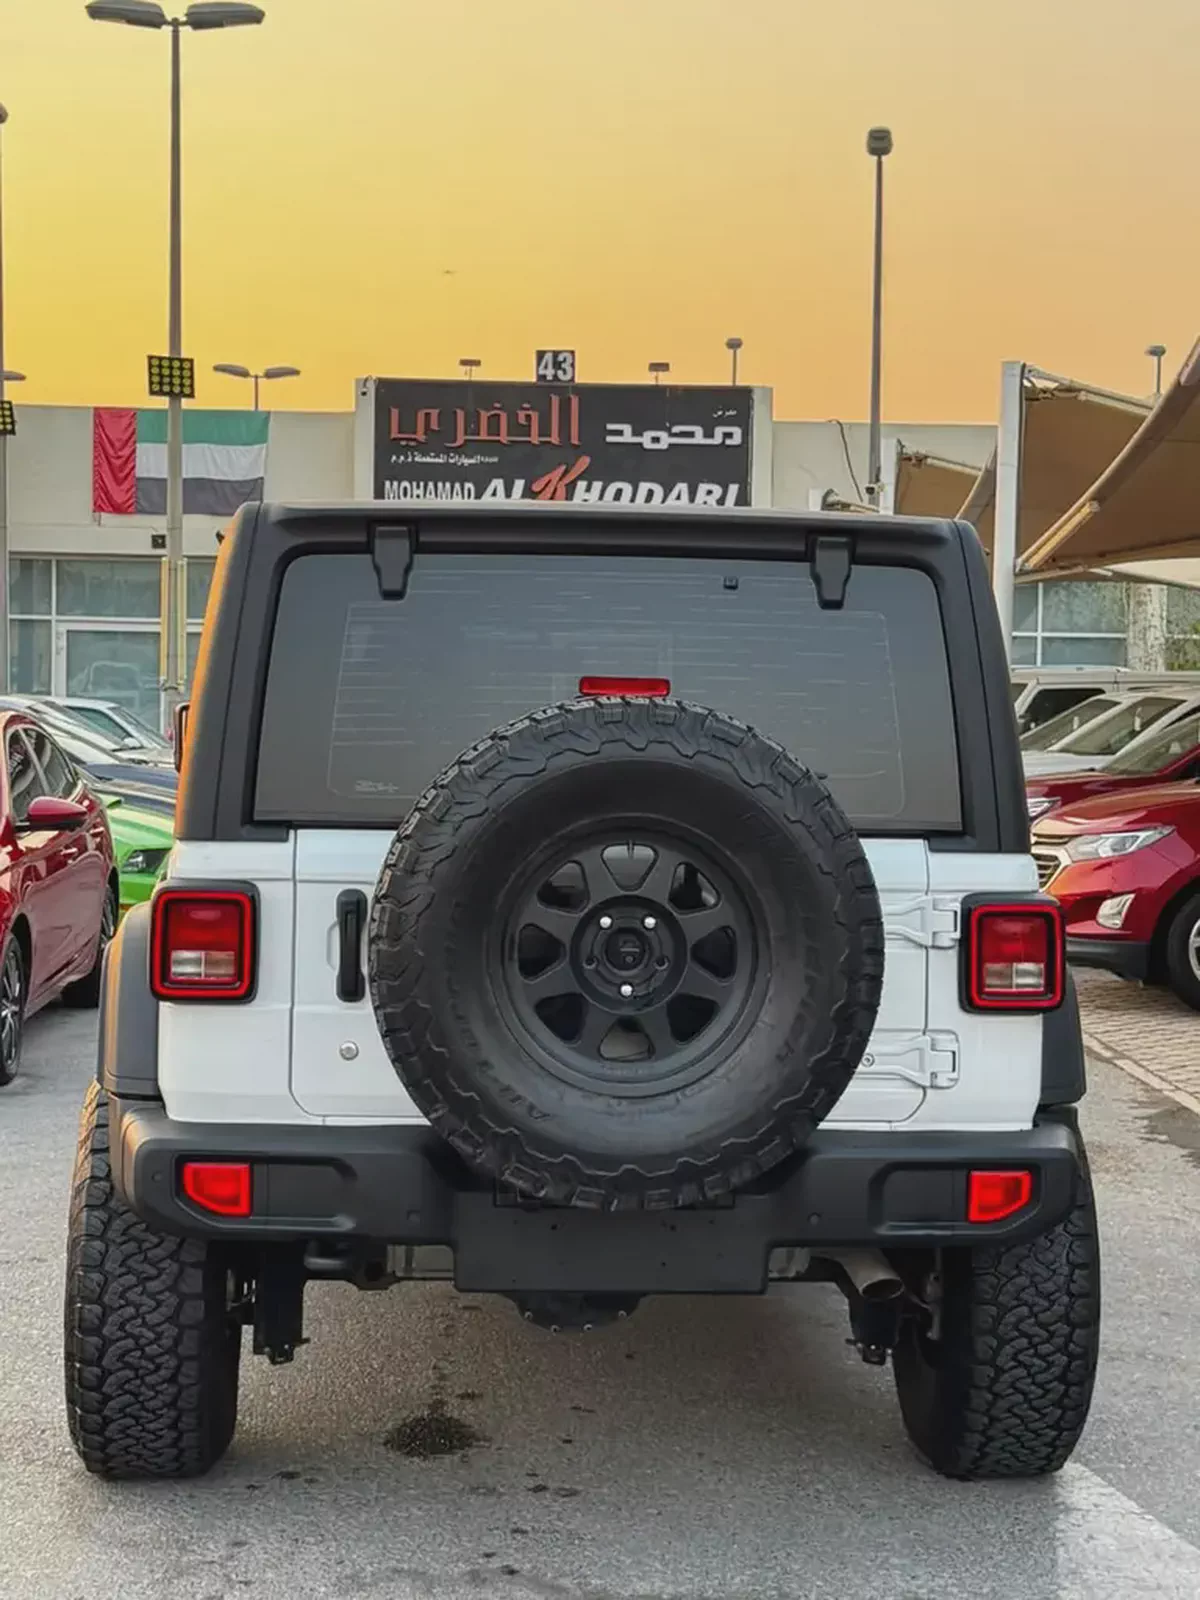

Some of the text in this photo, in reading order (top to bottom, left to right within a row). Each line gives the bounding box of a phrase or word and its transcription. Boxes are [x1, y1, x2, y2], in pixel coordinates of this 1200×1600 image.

[538, 351, 573, 381] 43
[389, 393, 742, 450] محمد الخضري
[384, 480, 475, 500] MOHAMAD
